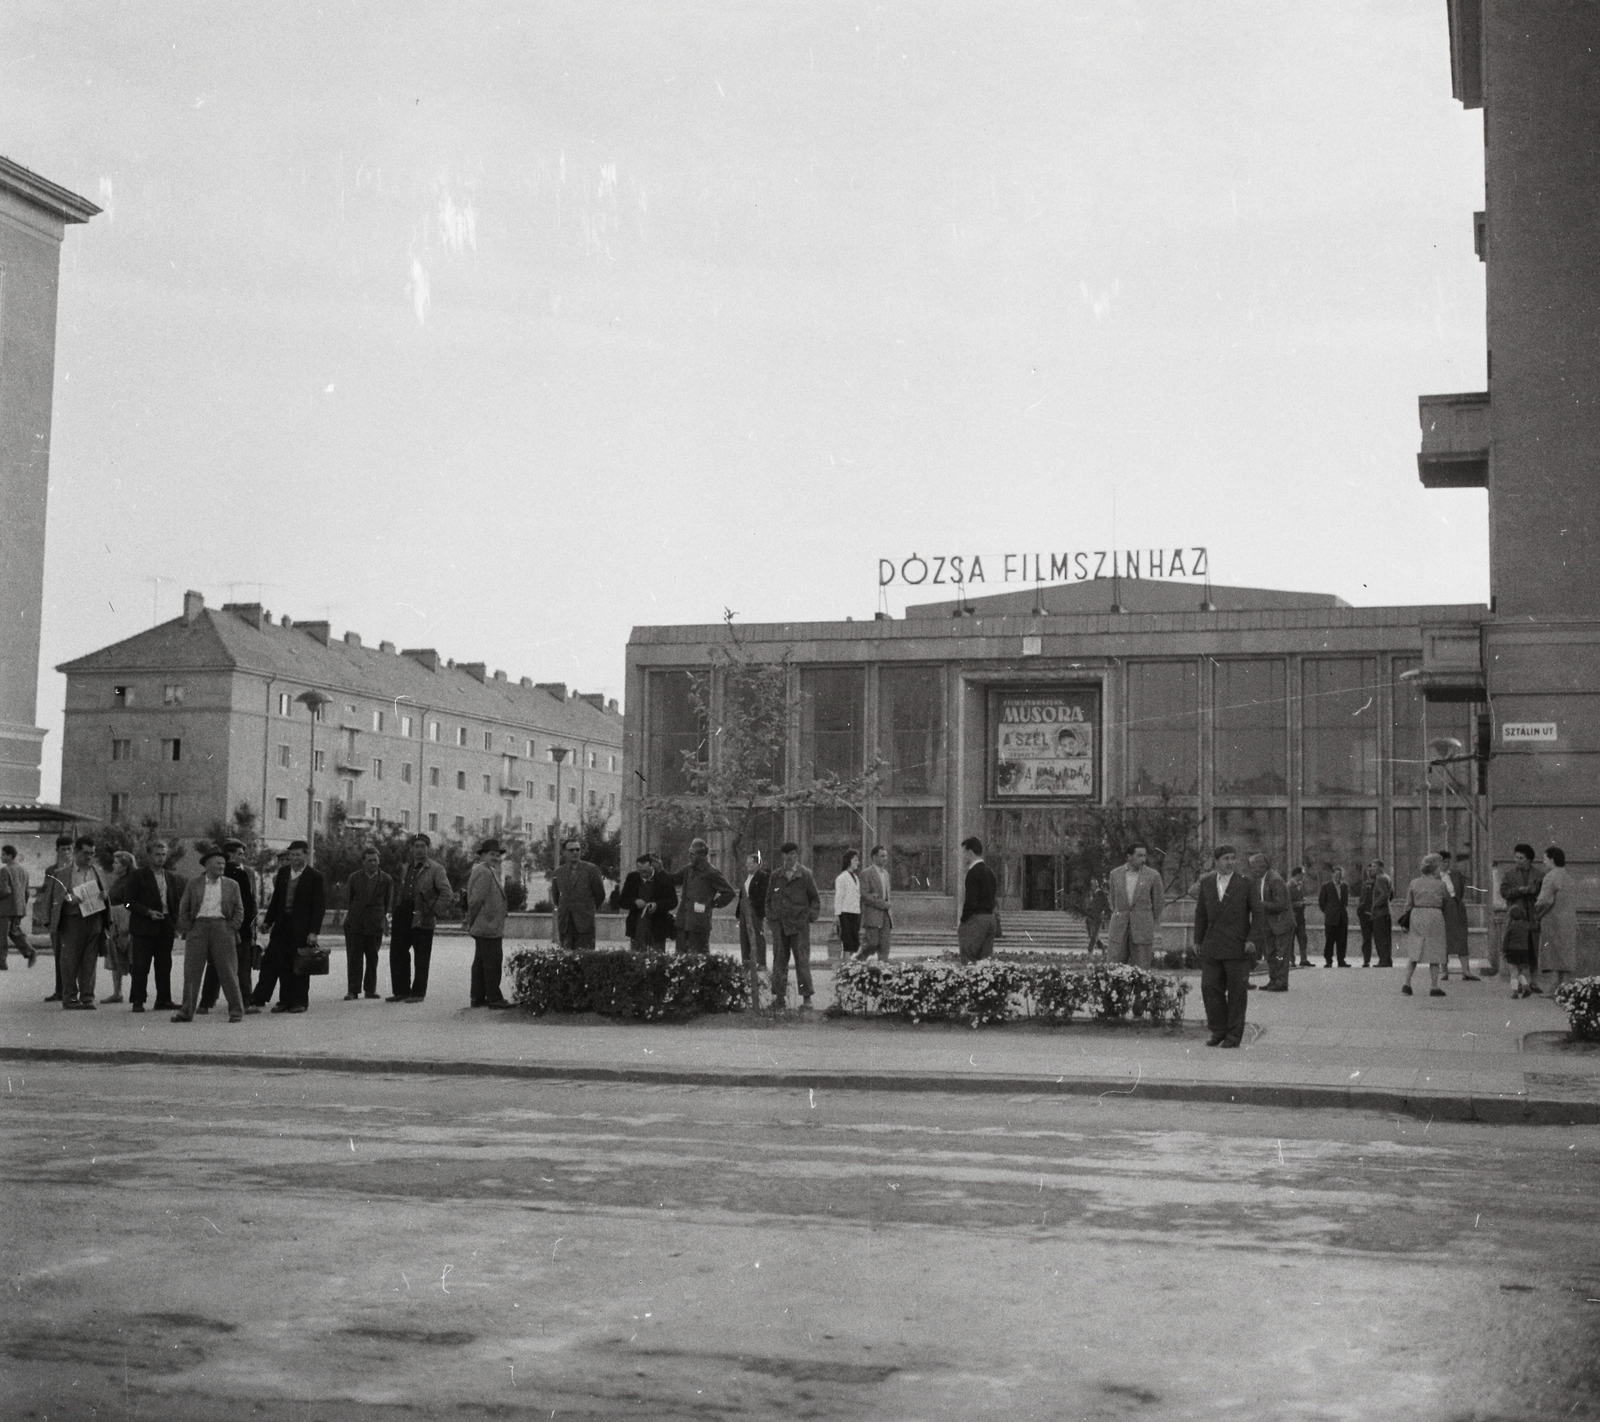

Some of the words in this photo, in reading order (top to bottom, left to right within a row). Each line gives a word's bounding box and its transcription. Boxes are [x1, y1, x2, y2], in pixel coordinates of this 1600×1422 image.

[879, 552, 986, 586] DÓZSA
[1003, 733, 1011, 746] A
[1015, 728, 1049, 747] SZÉL
[1025, 766, 1032, 779] A
